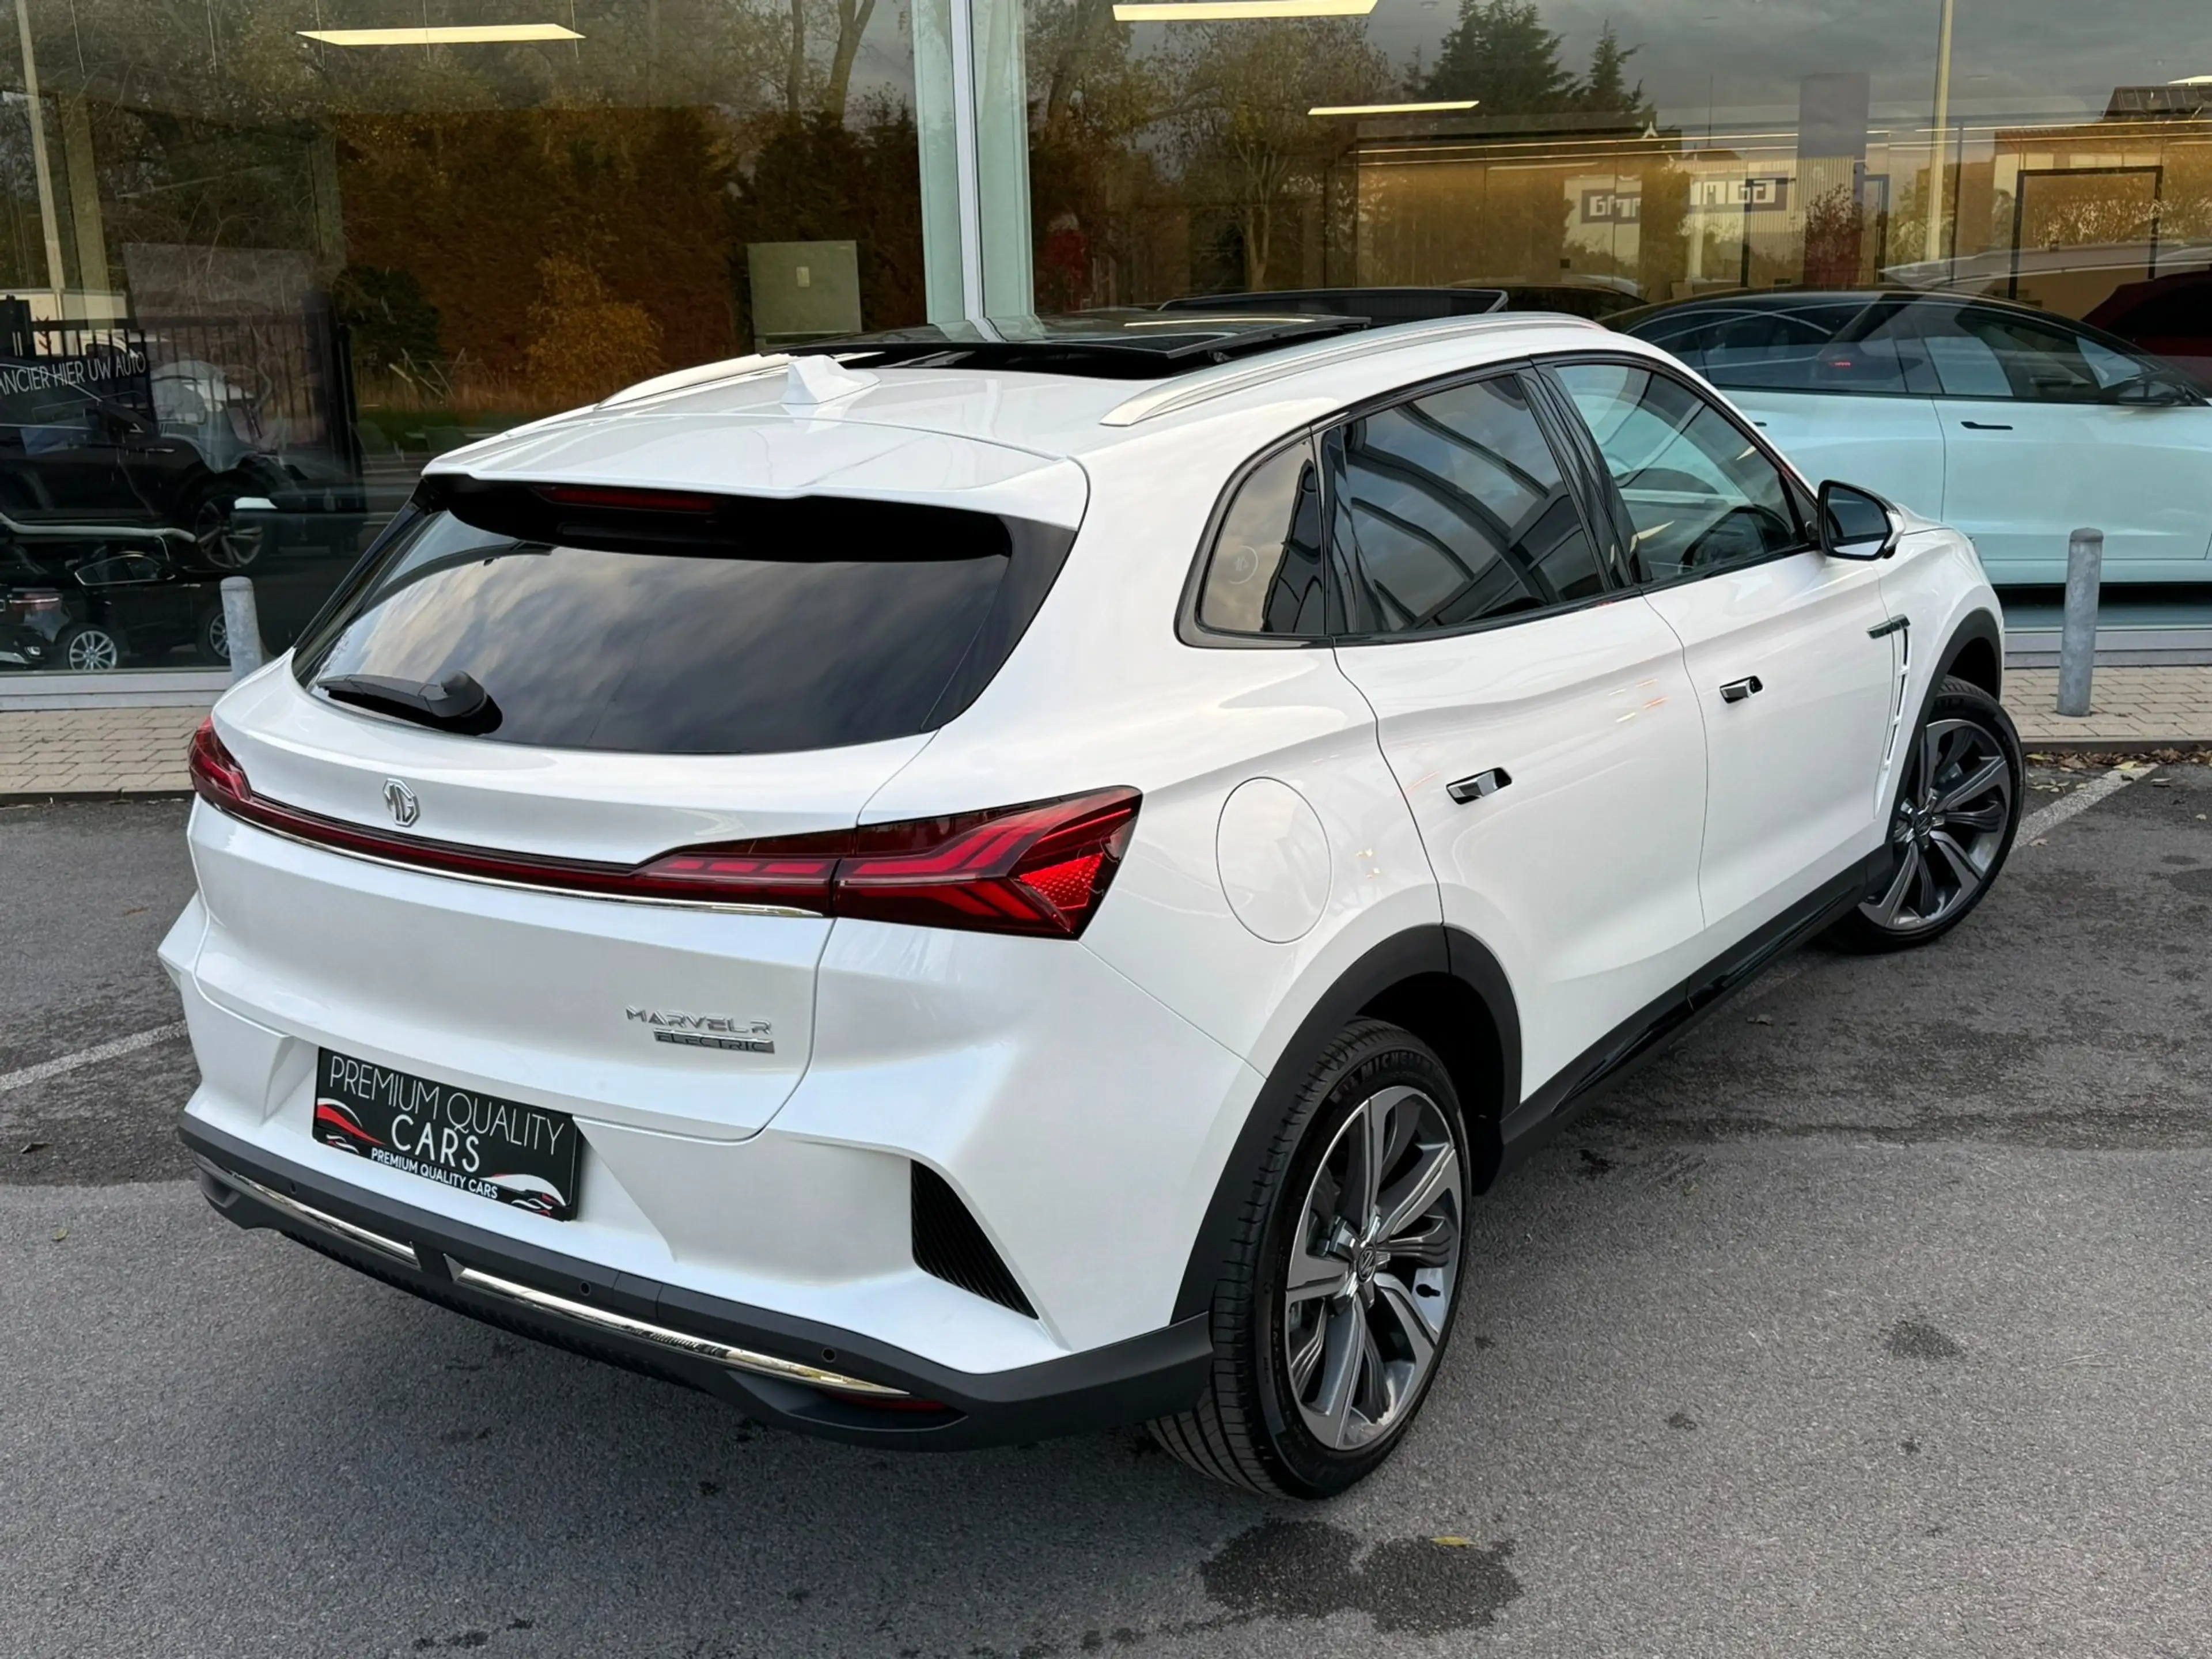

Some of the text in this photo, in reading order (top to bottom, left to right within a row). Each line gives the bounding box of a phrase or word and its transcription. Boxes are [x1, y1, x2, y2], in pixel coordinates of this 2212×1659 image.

[52, 361, 85, 387] HIER
[87, 357, 112, 381] UW
[116, 351, 146, 377] AUTO
[626, 1005, 772, 1035] MARVEL R
[656, 1031, 771, 1053] ELECTRIC
[329, 1055, 565, 1155] PREMIUM QUALITY
[391, 1114, 480, 1173] CARS
[371, 1147, 498, 1199] PREMIUM QUALITY CARS
